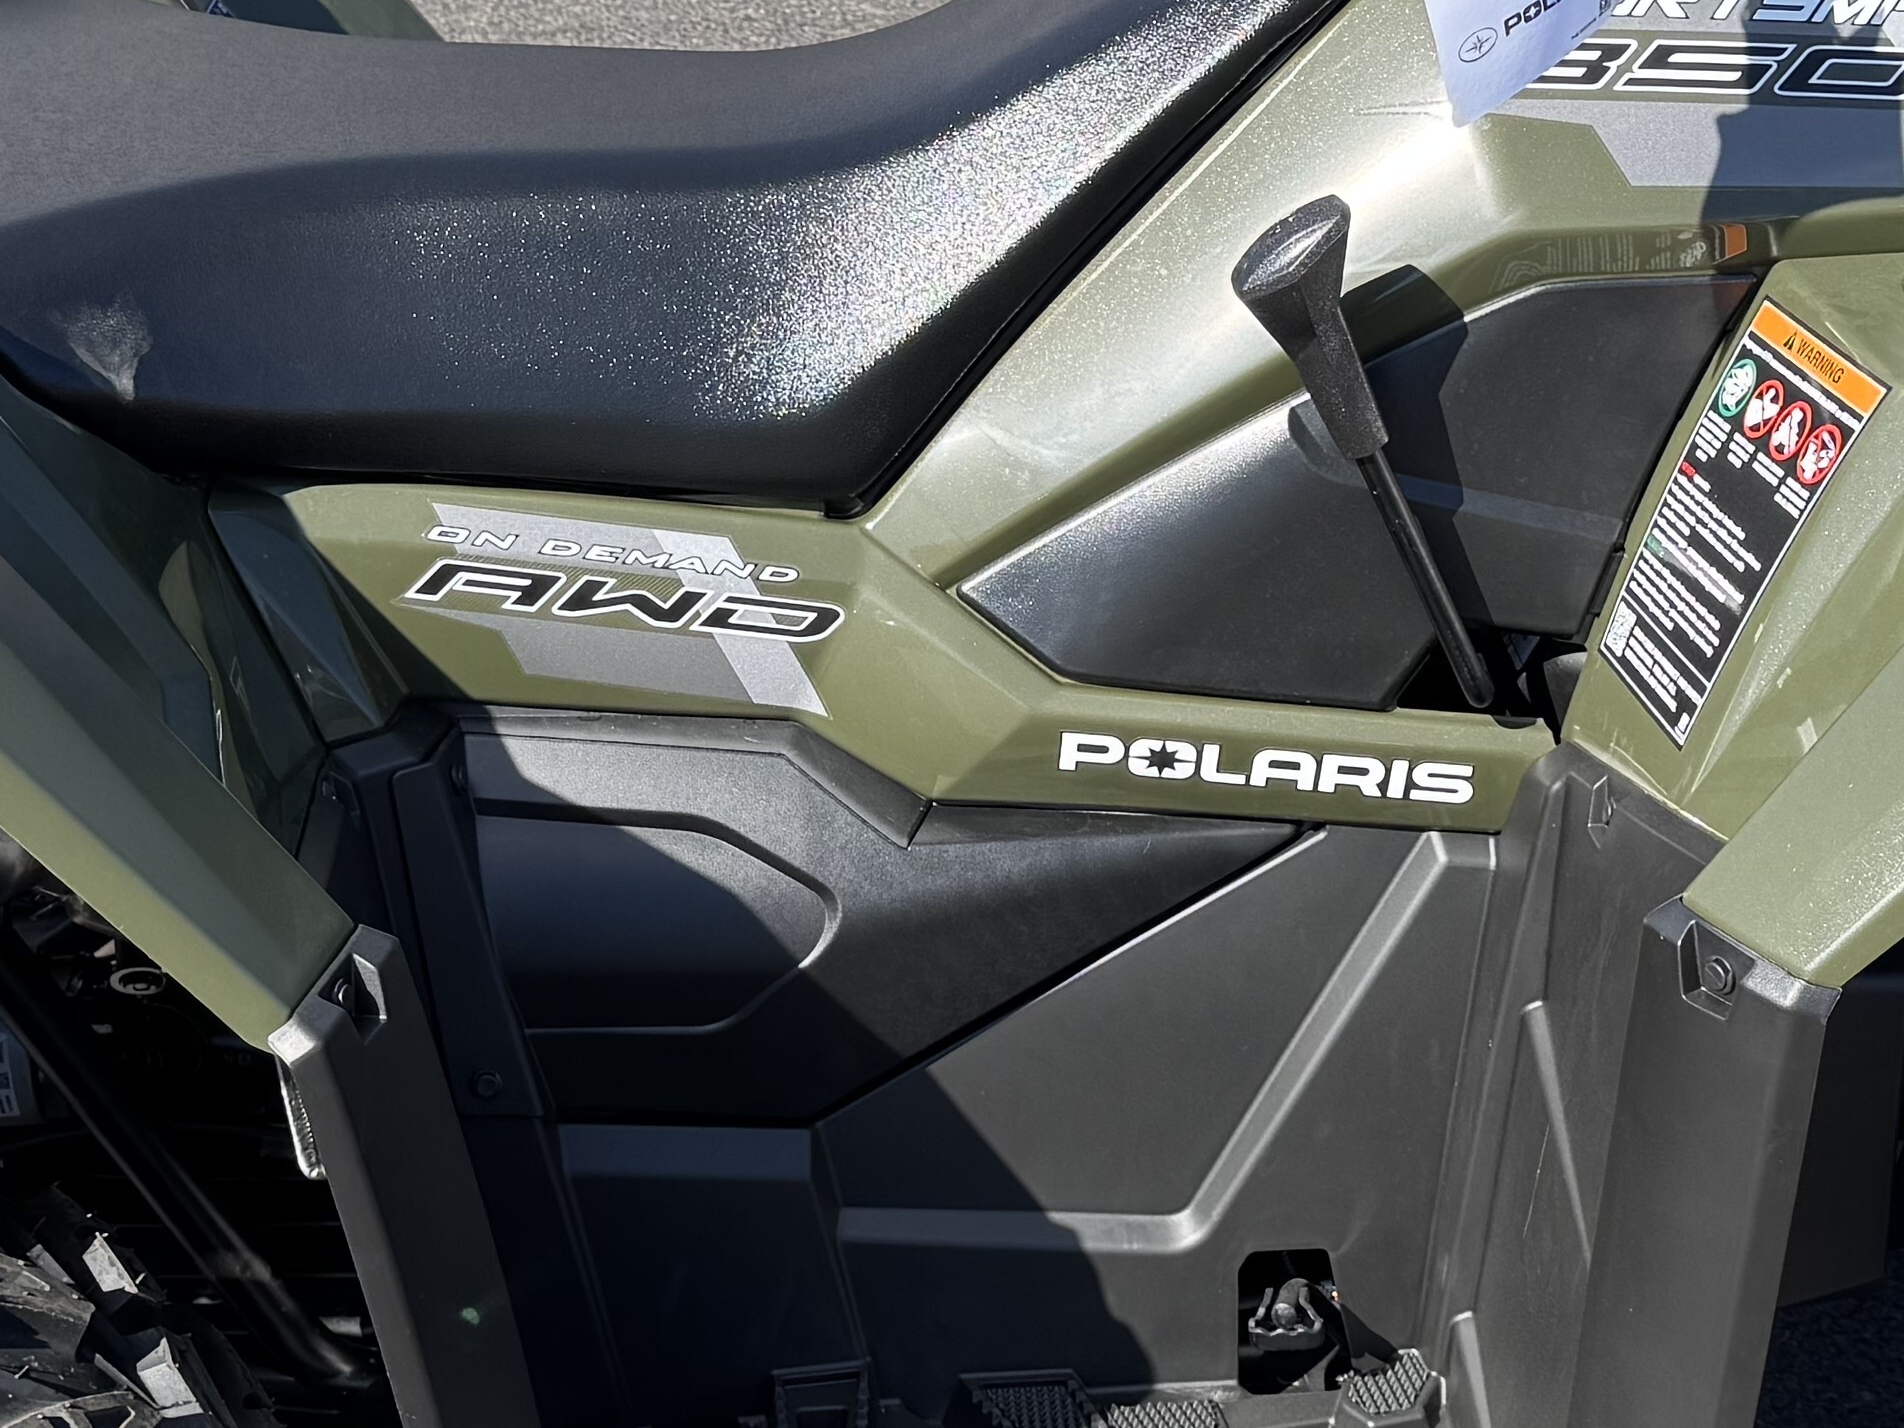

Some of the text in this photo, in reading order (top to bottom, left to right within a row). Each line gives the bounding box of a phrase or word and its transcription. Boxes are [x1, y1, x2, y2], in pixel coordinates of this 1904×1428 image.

[1793, 337, 1845, 386] WARNING
[427, 525, 800, 584] ON DEMAND
[404, 558, 845, 643] AWD
[1058, 731, 1474, 804] POLARIS
